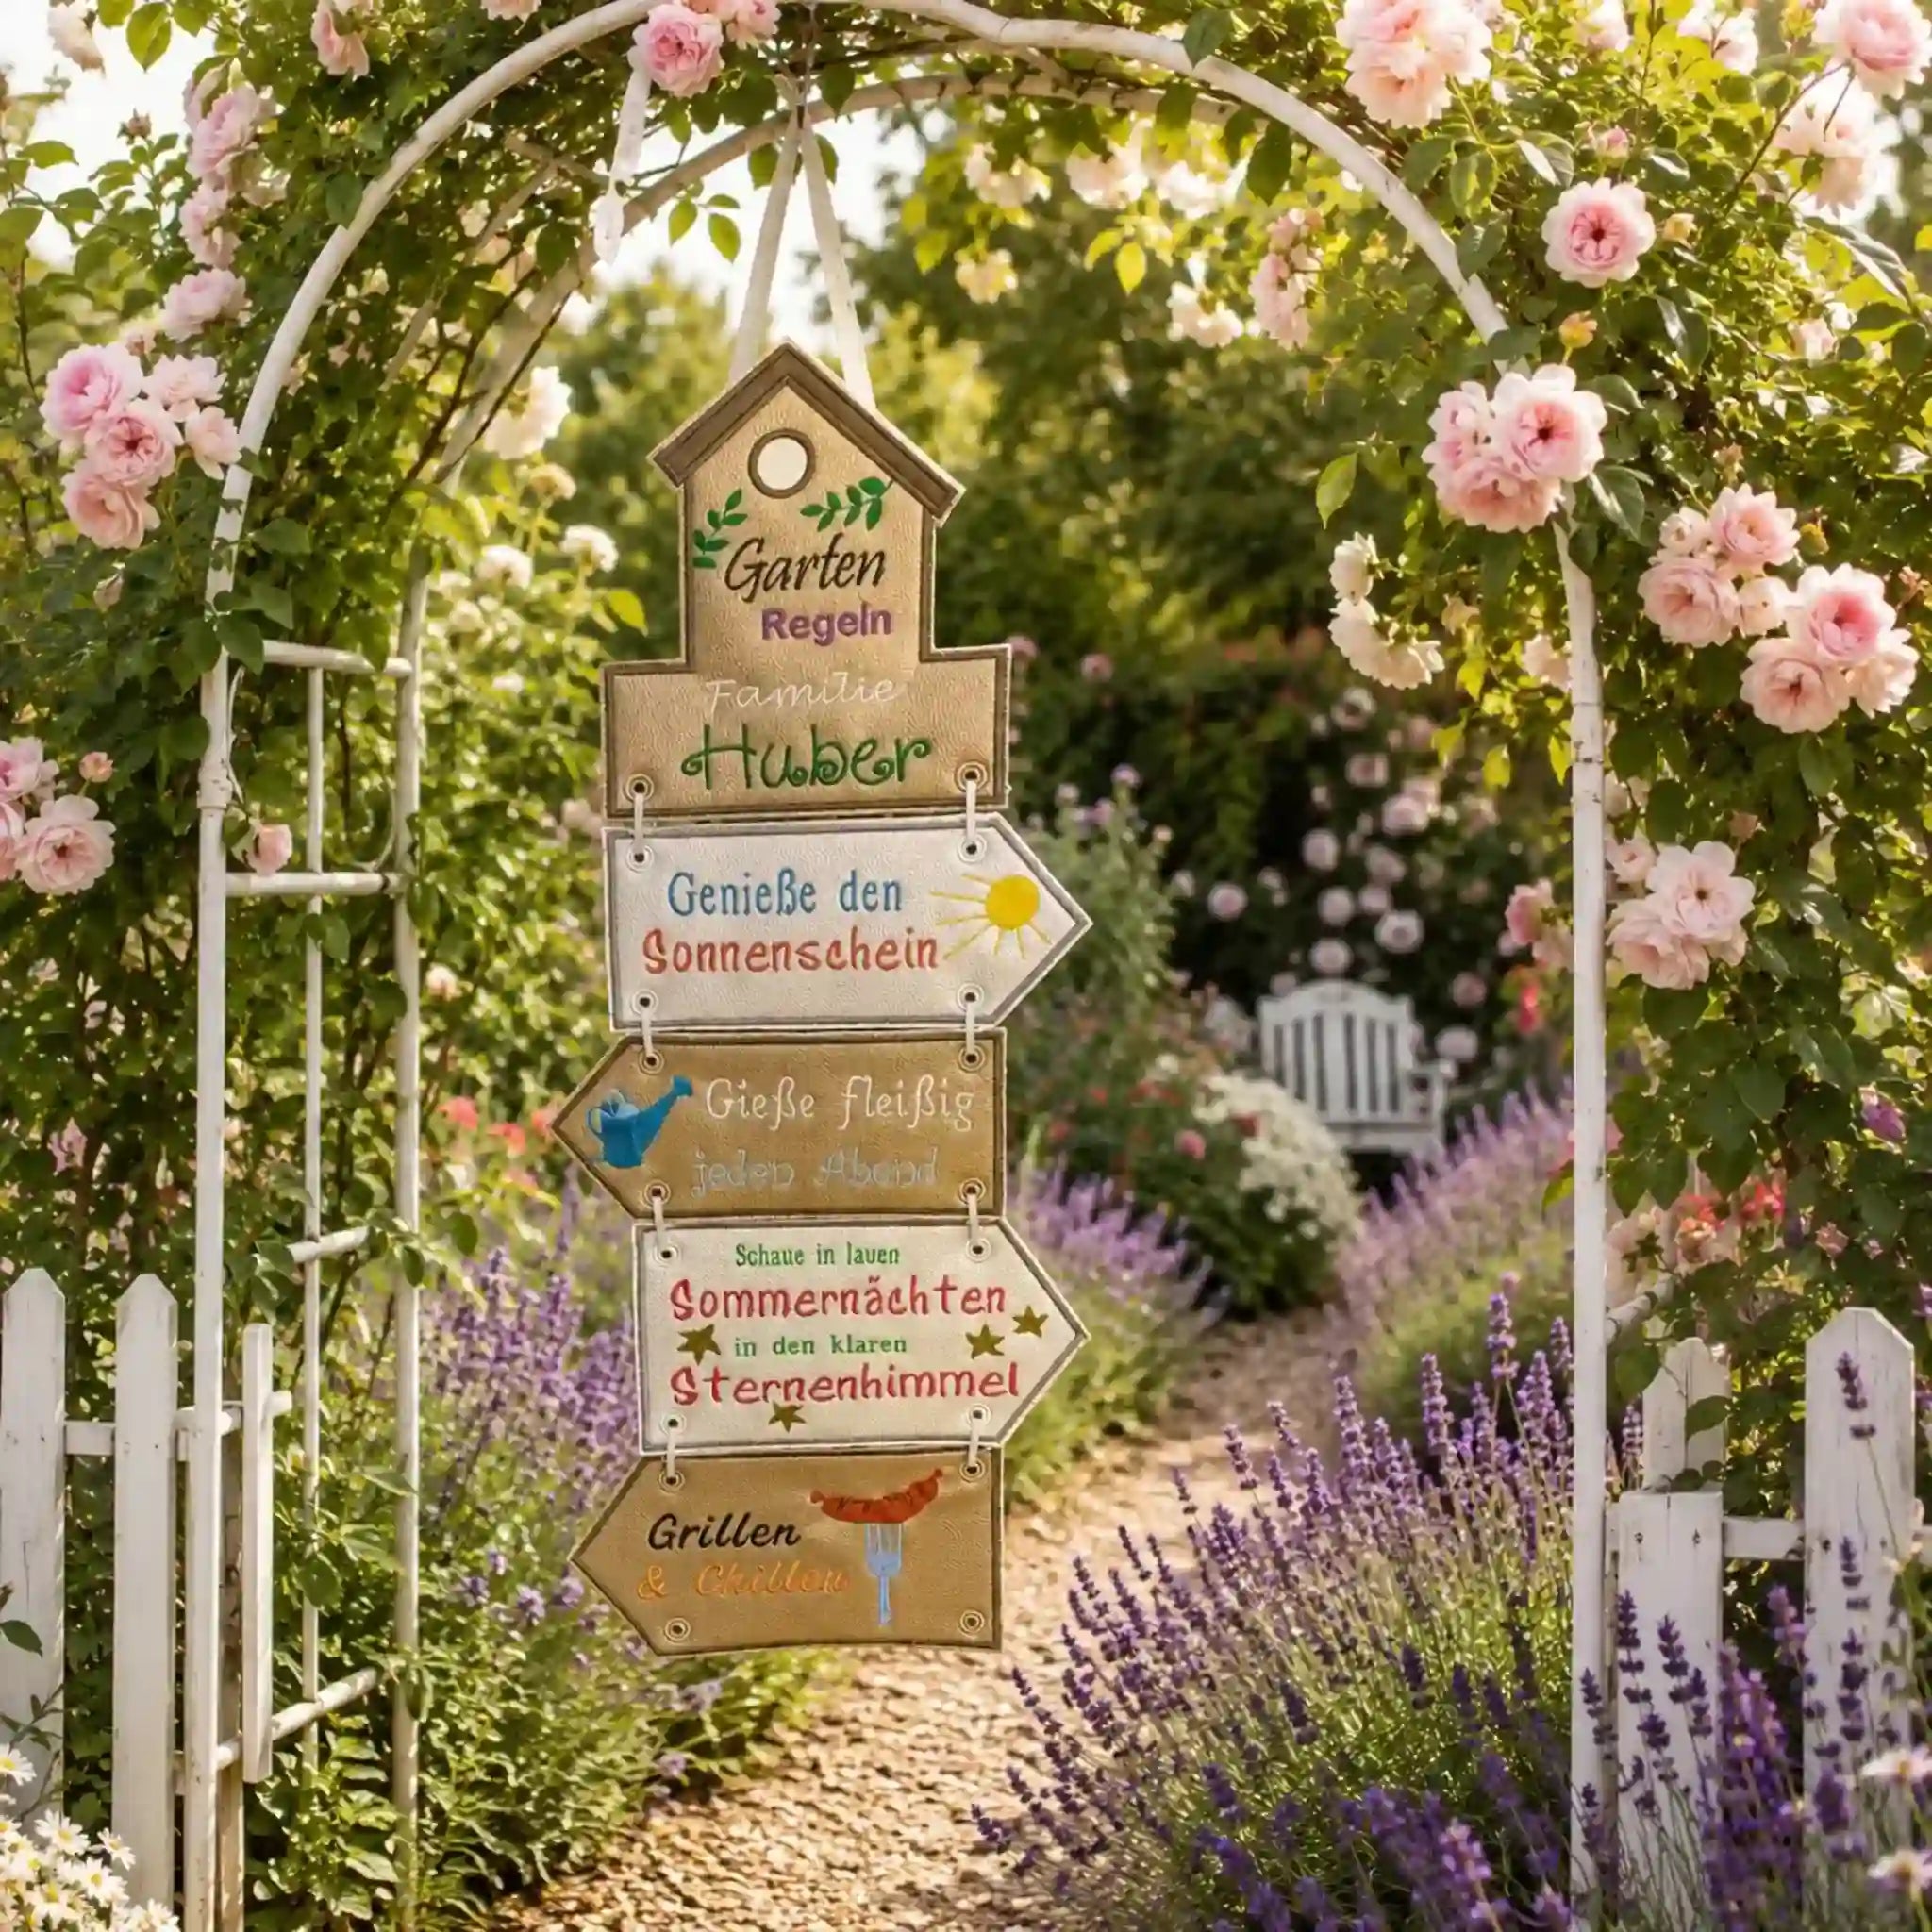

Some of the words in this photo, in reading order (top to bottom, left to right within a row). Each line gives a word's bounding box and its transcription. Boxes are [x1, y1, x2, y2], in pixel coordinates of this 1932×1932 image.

[724, 533, 886, 602] Garten
[761, 602, 892, 646] Regeln
[706, 671, 899, 714] Familie
[680, 724, 932, 790] Huber
[667, 868, 816, 917] Genieße
[839, 869, 903, 913] den
[642, 925, 938, 974] Sonnenschein
[705, 1074, 815, 1131] Gieße
[839, 1074, 975, 1131] fleißig
[735, 1242, 805, 1266] Schaue
[816, 1242, 835, 1265] in
[846, 1241, 900, 1265] lauen
[670, 1274, 1006, 1321] Sommernächten
[734, 1337, 756, 1358] in
[772, 1333, 815, 1356] den
[830, 1333, 908, 1355] klaren
[670, 1362, 1019, 1406] Sternenhimmel
[647, 1512, 801, 1550] Grillen
[637, 1564, 668, 1600] &
